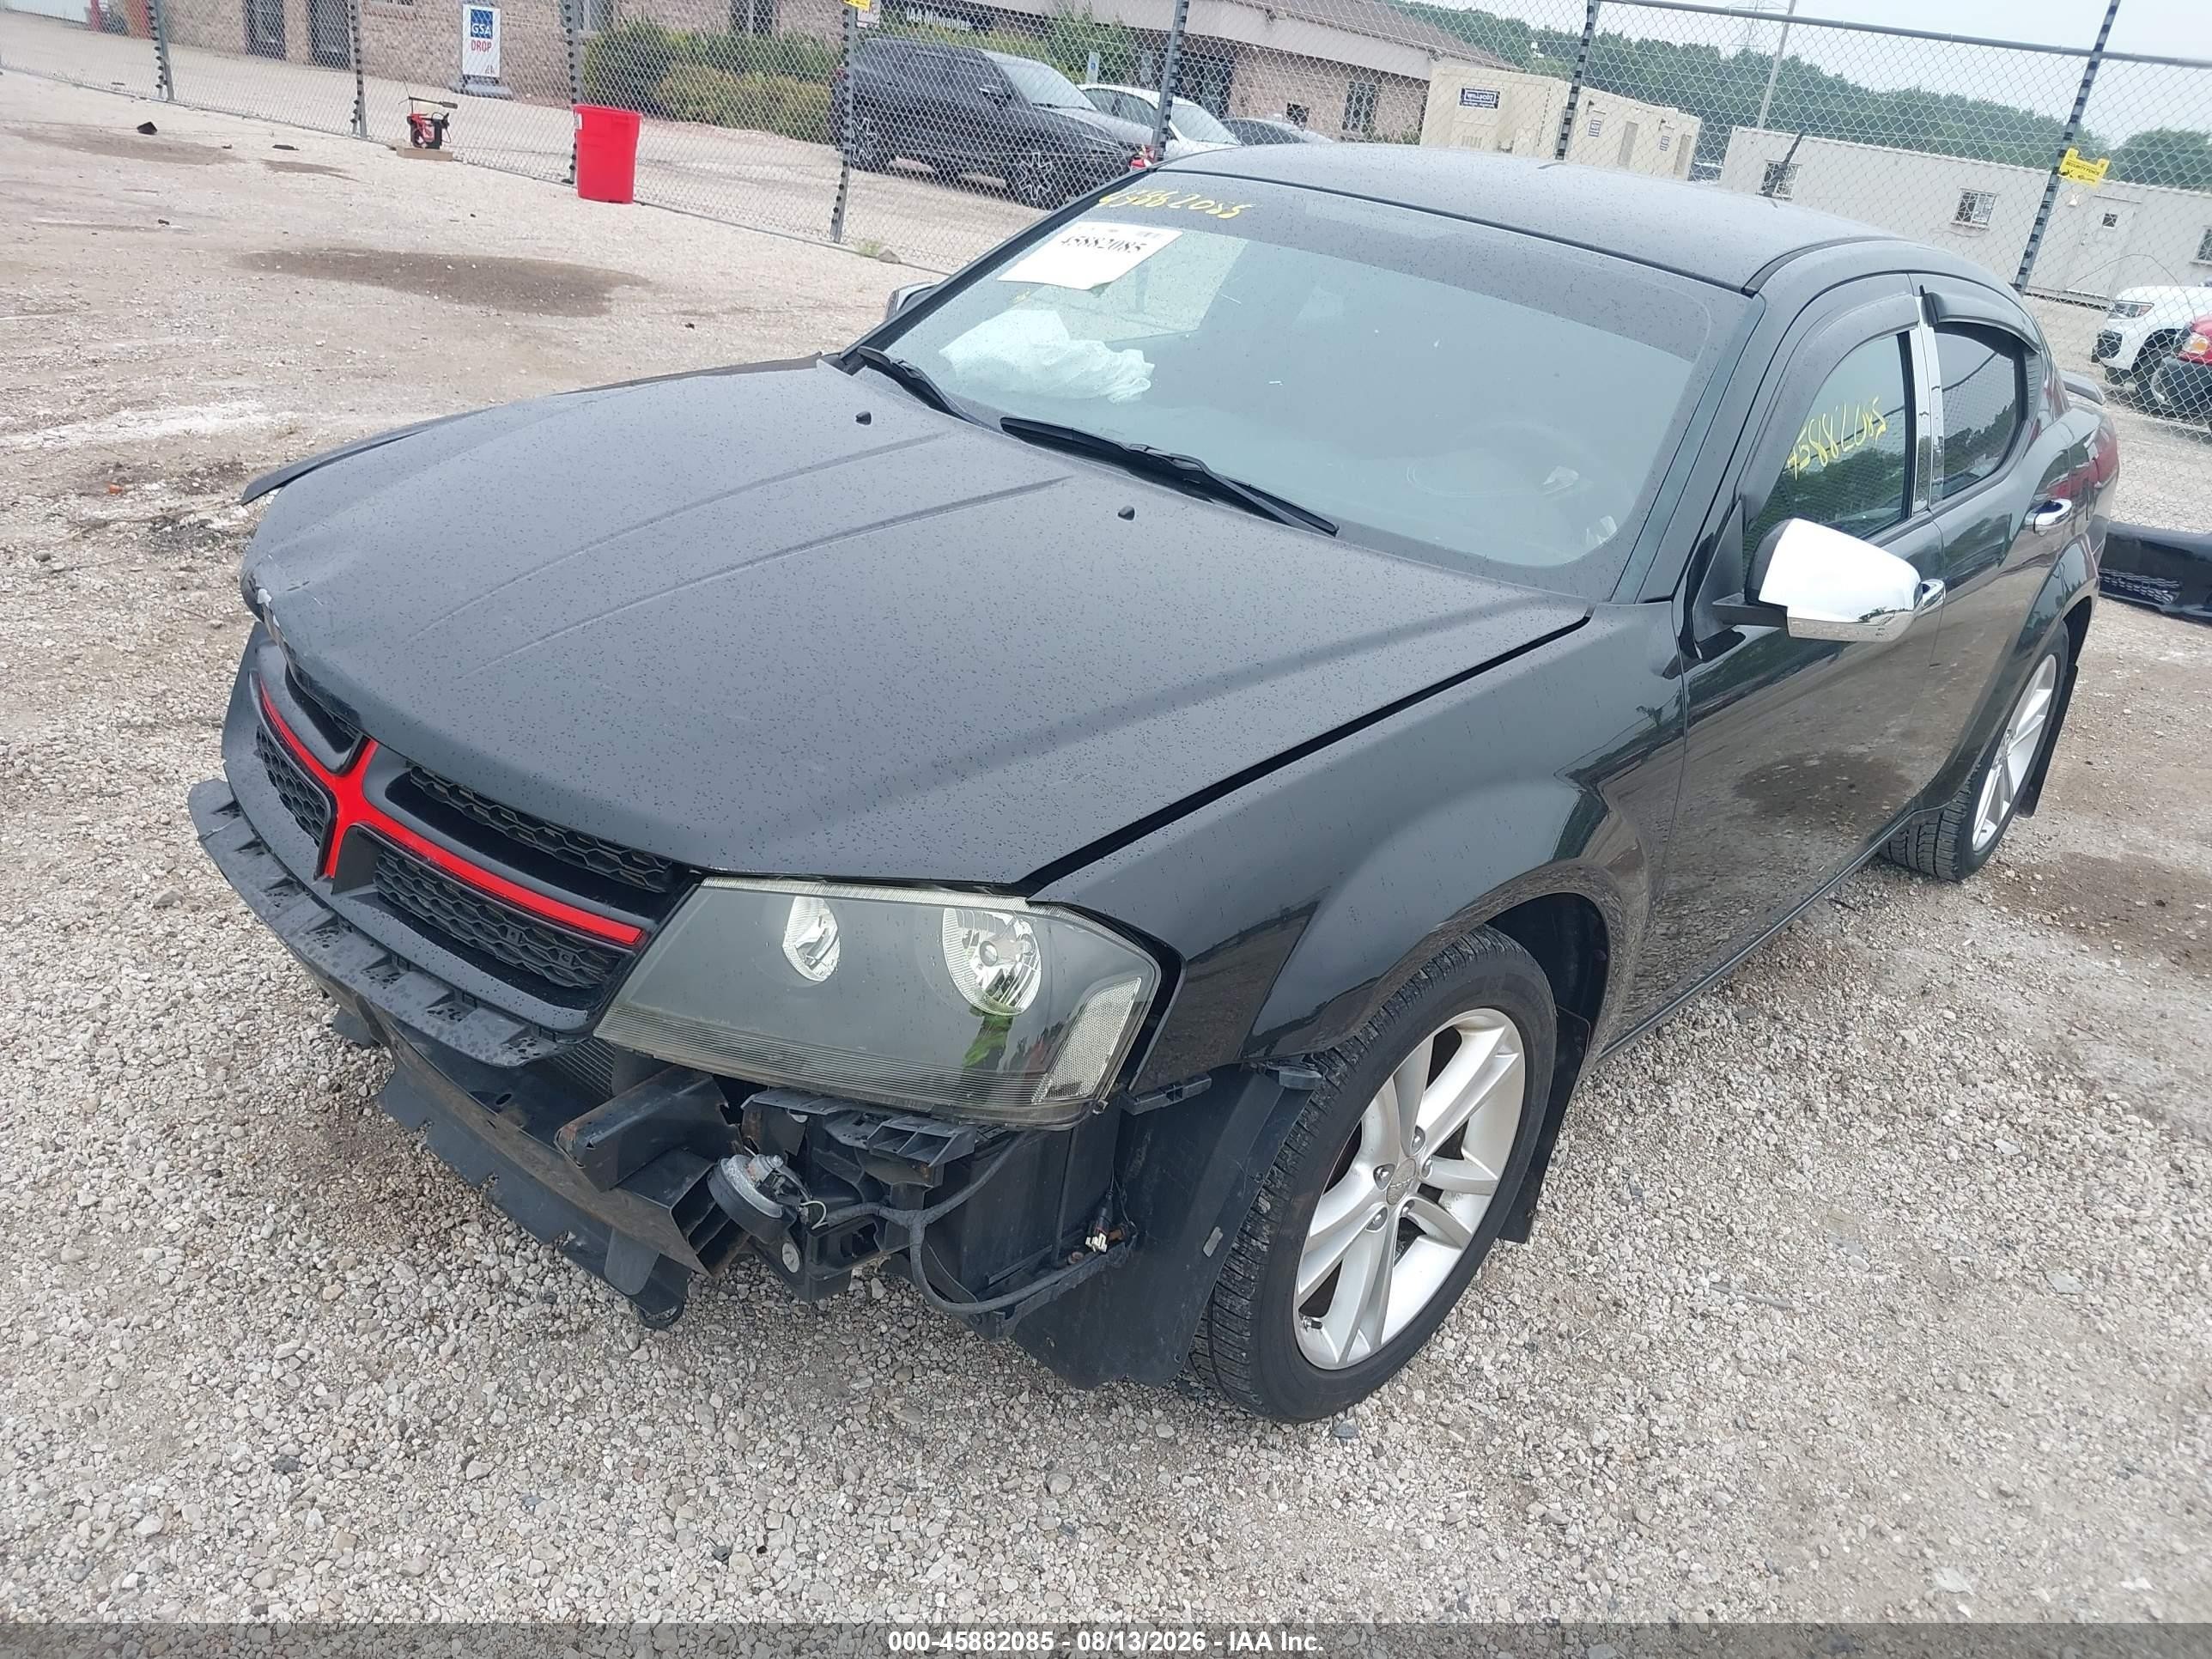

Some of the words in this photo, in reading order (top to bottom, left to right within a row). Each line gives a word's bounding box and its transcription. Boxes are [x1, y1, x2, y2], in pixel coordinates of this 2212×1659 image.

[906, 7, 922, 22] IAA
[925, 10, 970, 31] Milwaukee
[471, 23, 492, 34] GSA
[471, 40, 492, 52] DROP
[1467, 93, 1493, 101] WILLSCOT
[2066, 161, 2087, 172] SECURITY
[1060, 234, 1148, 254] 45882085
